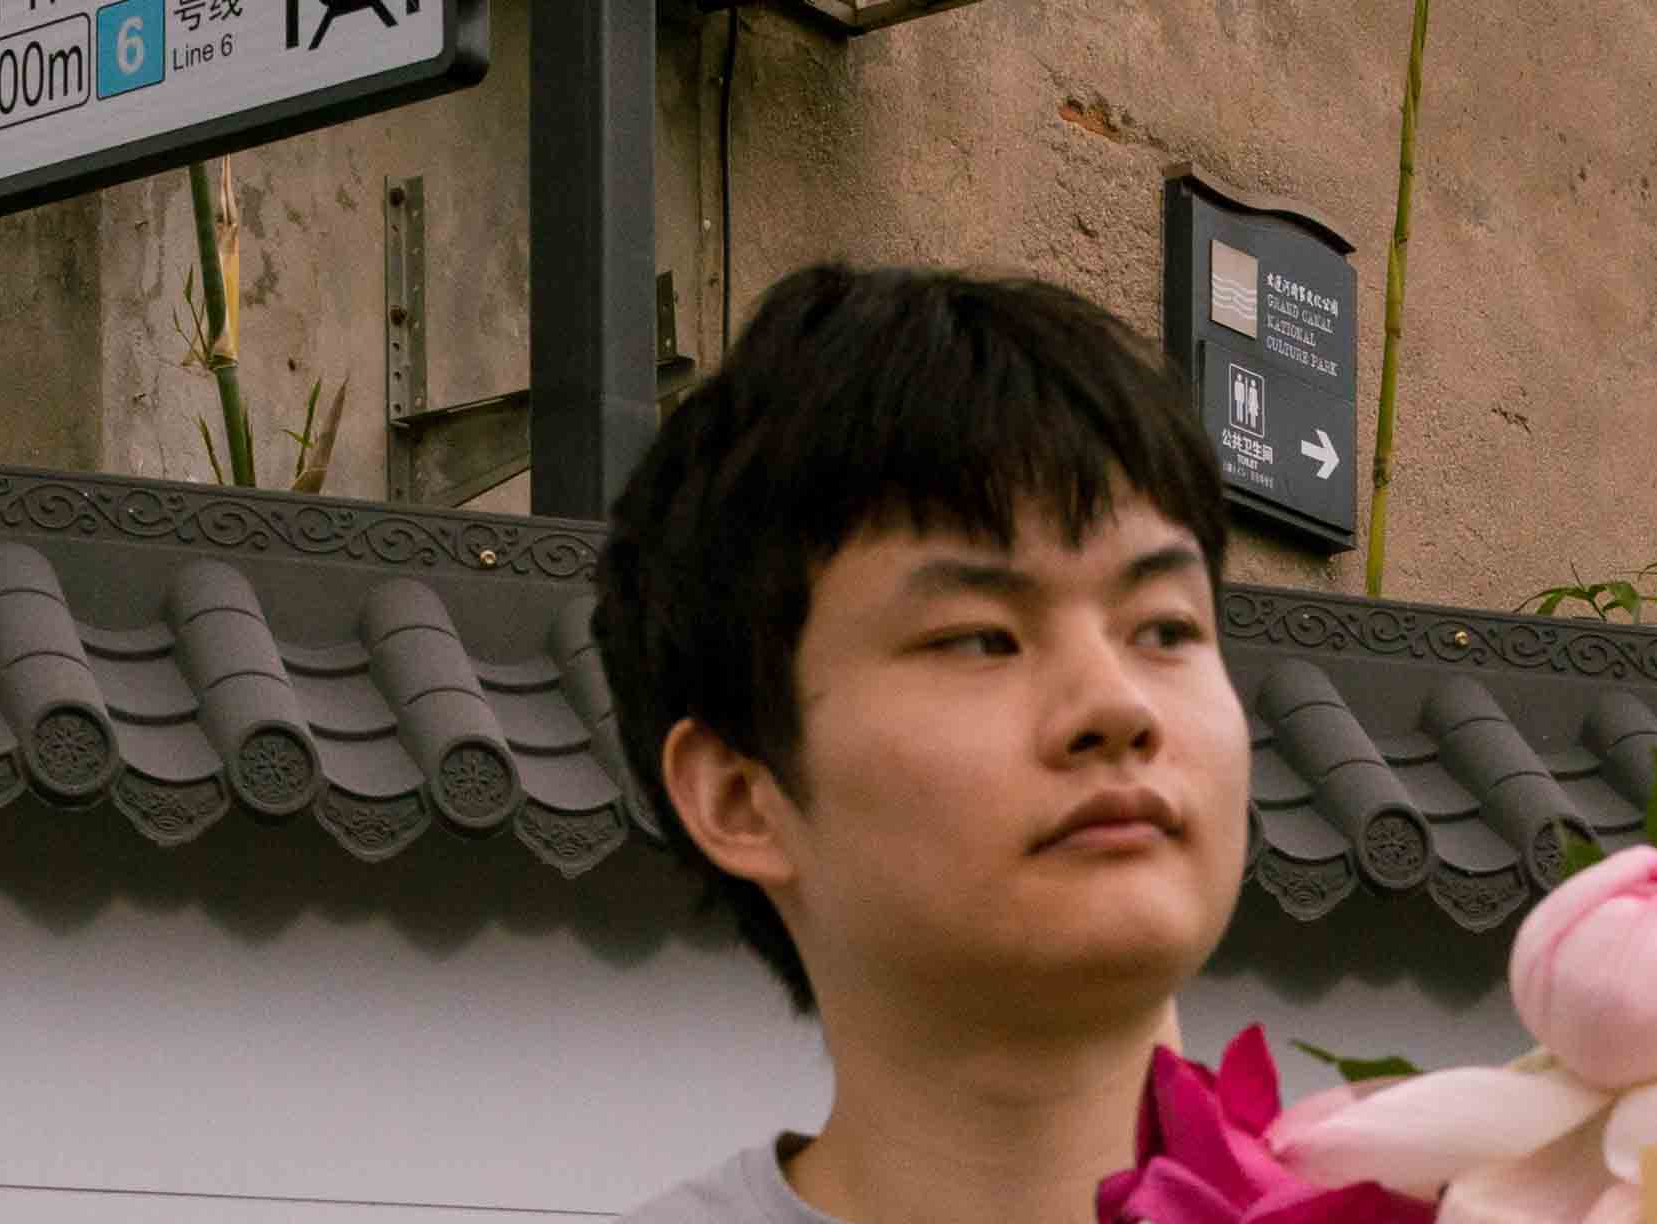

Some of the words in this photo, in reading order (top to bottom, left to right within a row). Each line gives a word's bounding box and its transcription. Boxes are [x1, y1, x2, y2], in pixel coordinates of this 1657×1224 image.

[116, 16, 144, 75] 6
[172, 42, 214, 70] Line
[220, 33, 233, 58] 6
[1267, 294, 1299, 320] GRAND
[1301, 309, 1334, 334] CANAL
[1267, 313, 1316, 347] NATIONAL
[1266, 335, 1309, 366] CULTURE
[1310, 353, 1338, 377] PARK
[1222, 428, 1273, 465] 公共卫生间
